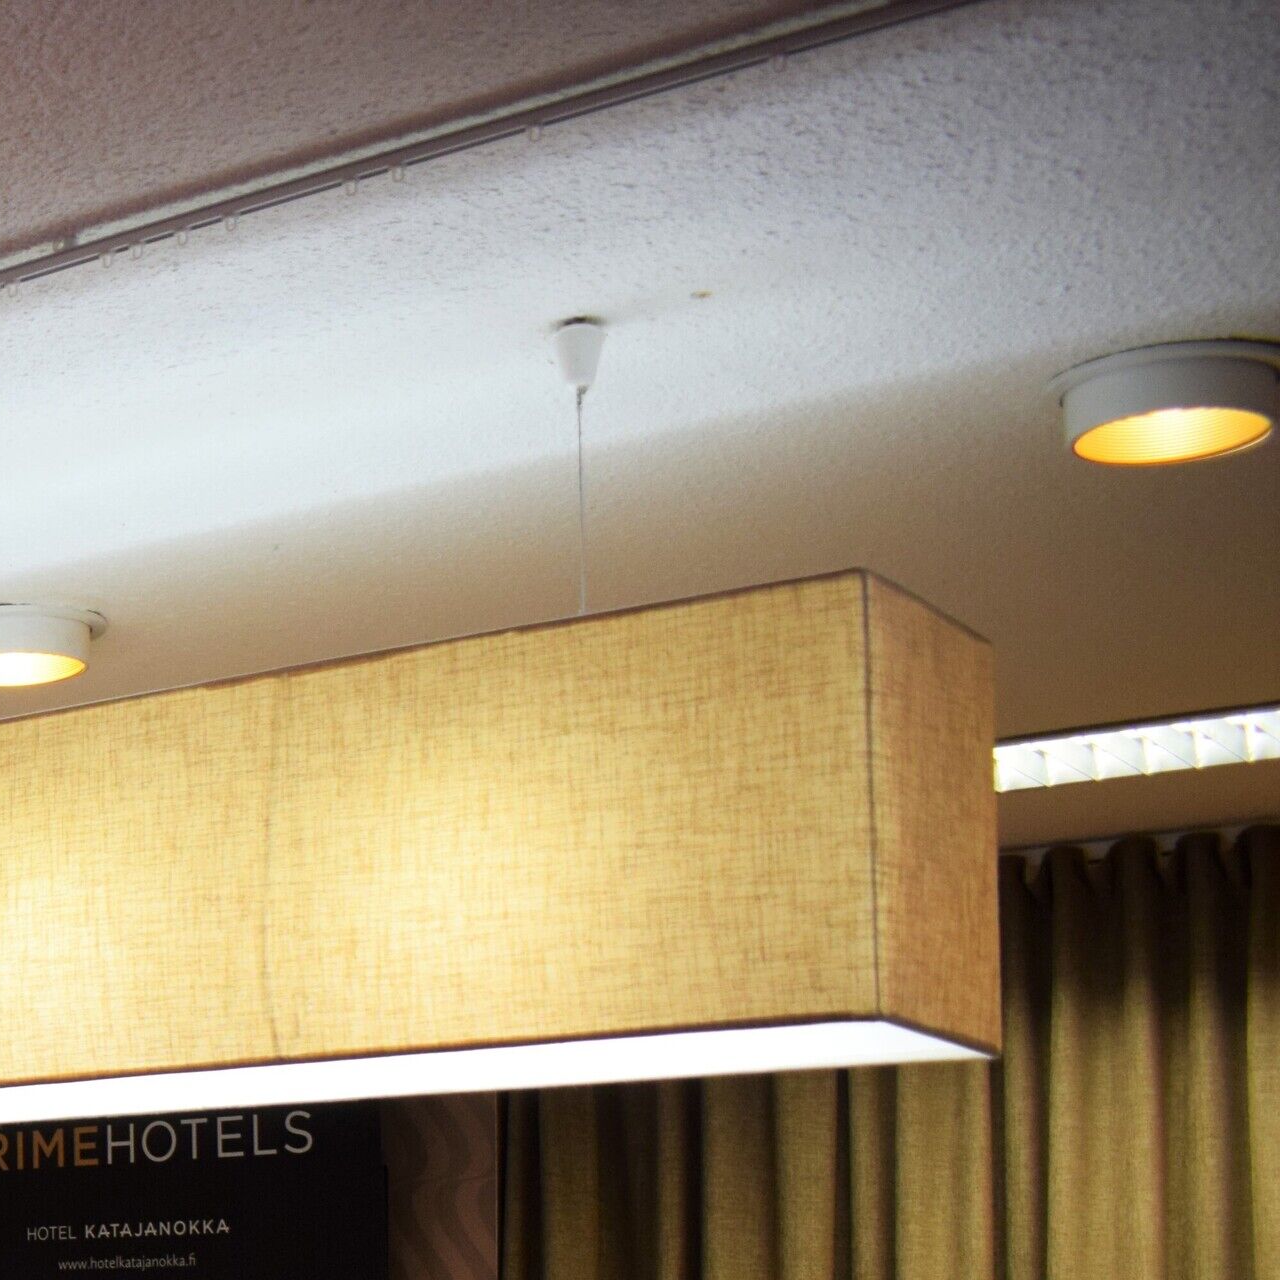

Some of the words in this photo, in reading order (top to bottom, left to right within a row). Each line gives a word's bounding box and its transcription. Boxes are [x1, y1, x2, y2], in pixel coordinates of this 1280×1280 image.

[27, 1225, 77, 1242] HOTEL
[84, 1217, 230, 1240] KATAJANOKKA
[57, 1251, 197, 1273] www.hotelkatajanokka.fi
